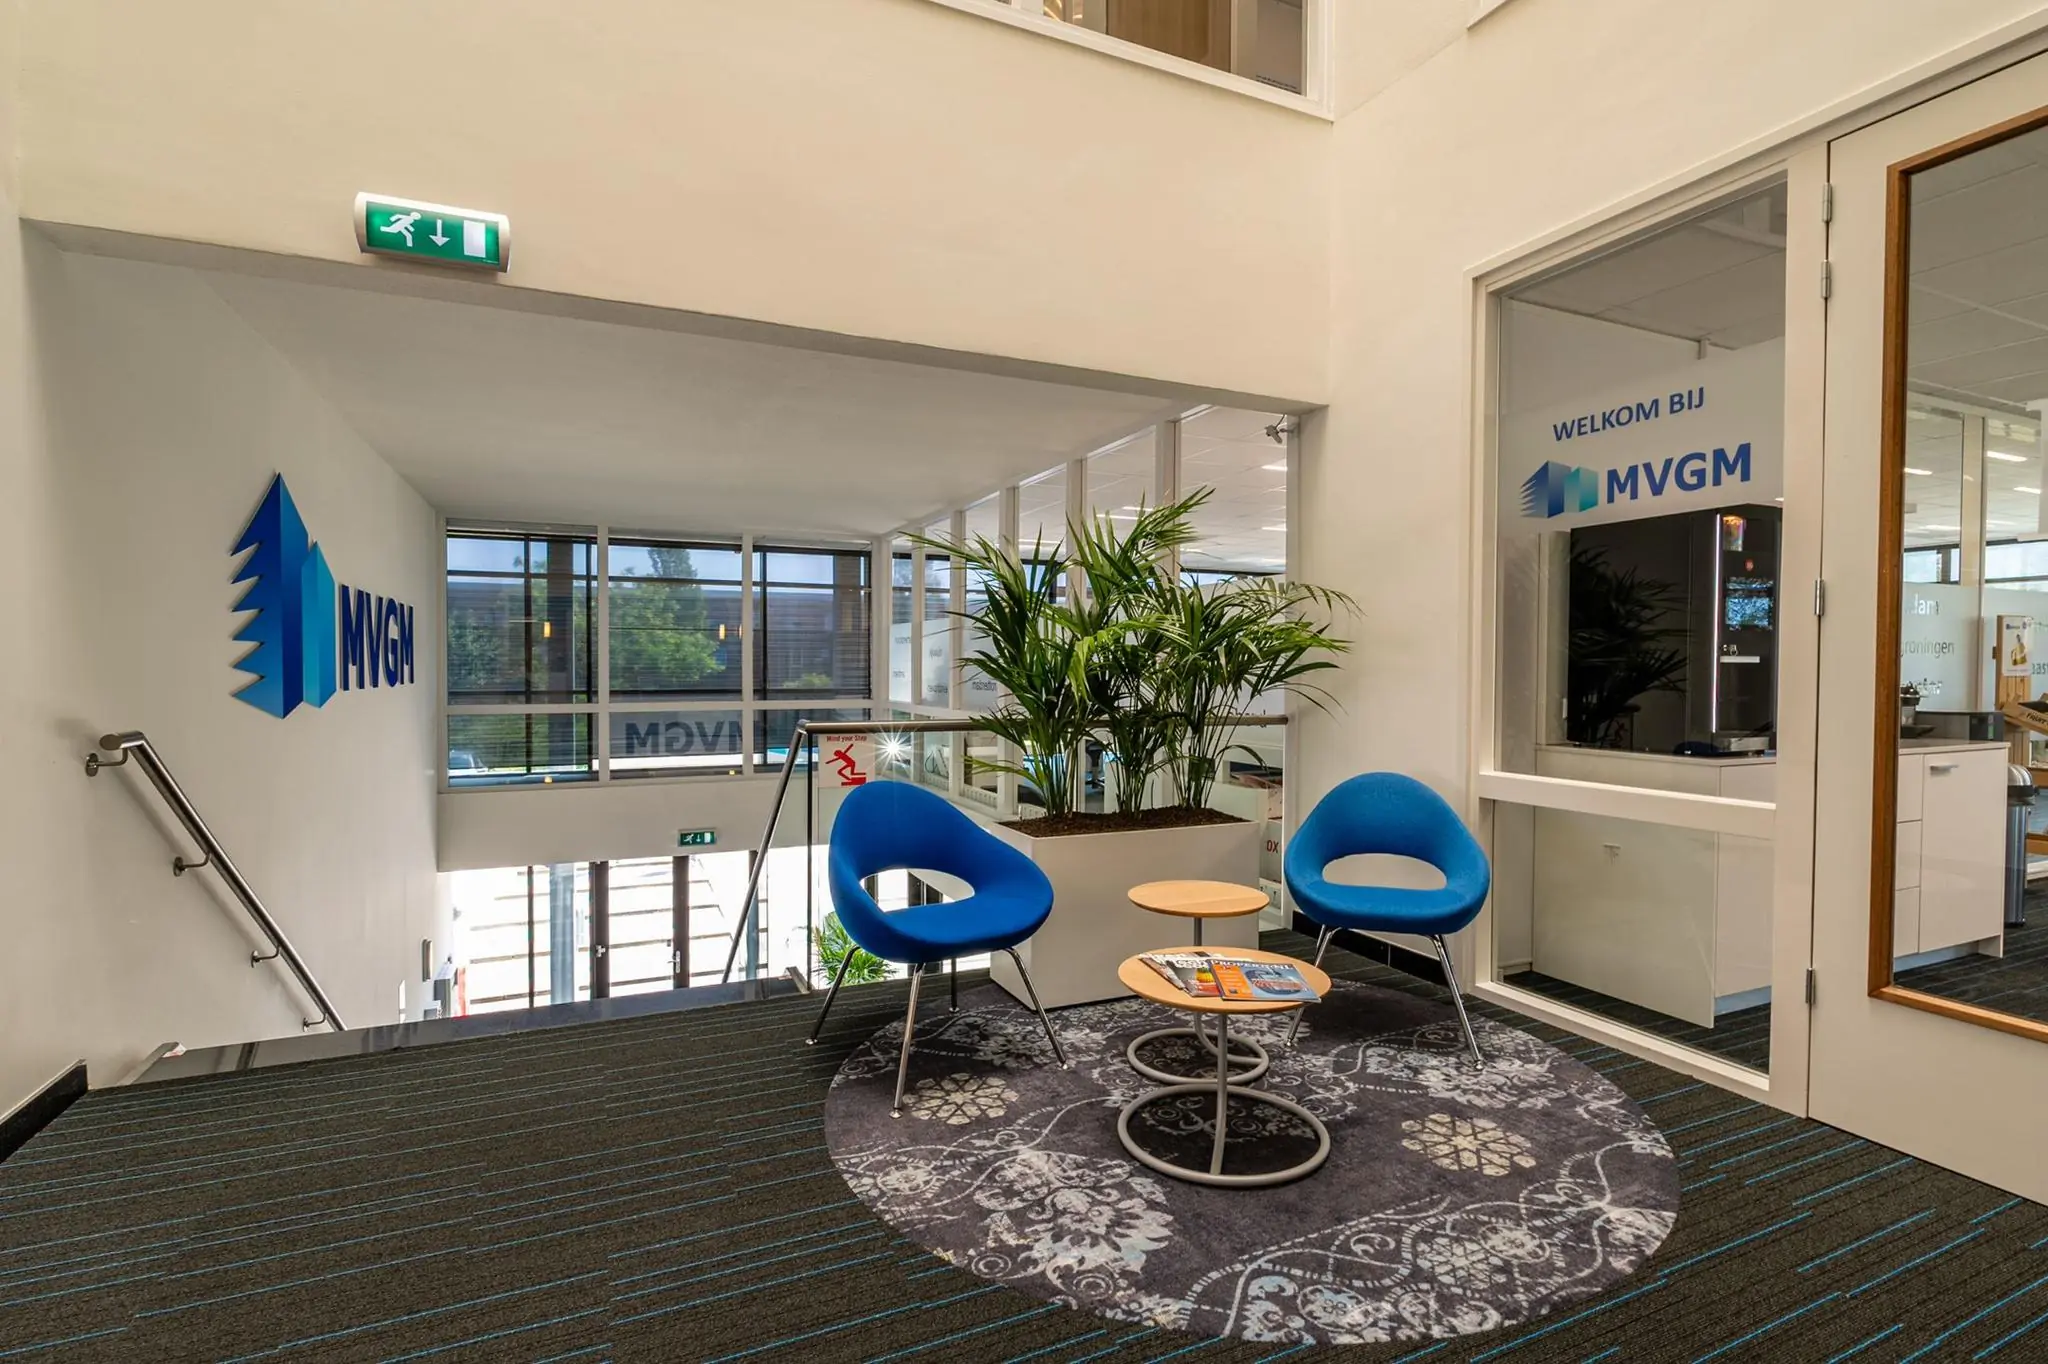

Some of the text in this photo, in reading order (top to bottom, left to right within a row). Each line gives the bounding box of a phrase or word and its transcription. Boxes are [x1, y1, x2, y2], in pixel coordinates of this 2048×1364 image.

[1553, 387, 1704, 441] WELKOM BIJ
[1607, 442, 1751, 504] MVGM
[340, 583, 414, 691] MVGM
[1900, 637, 1955, 659] roningen
